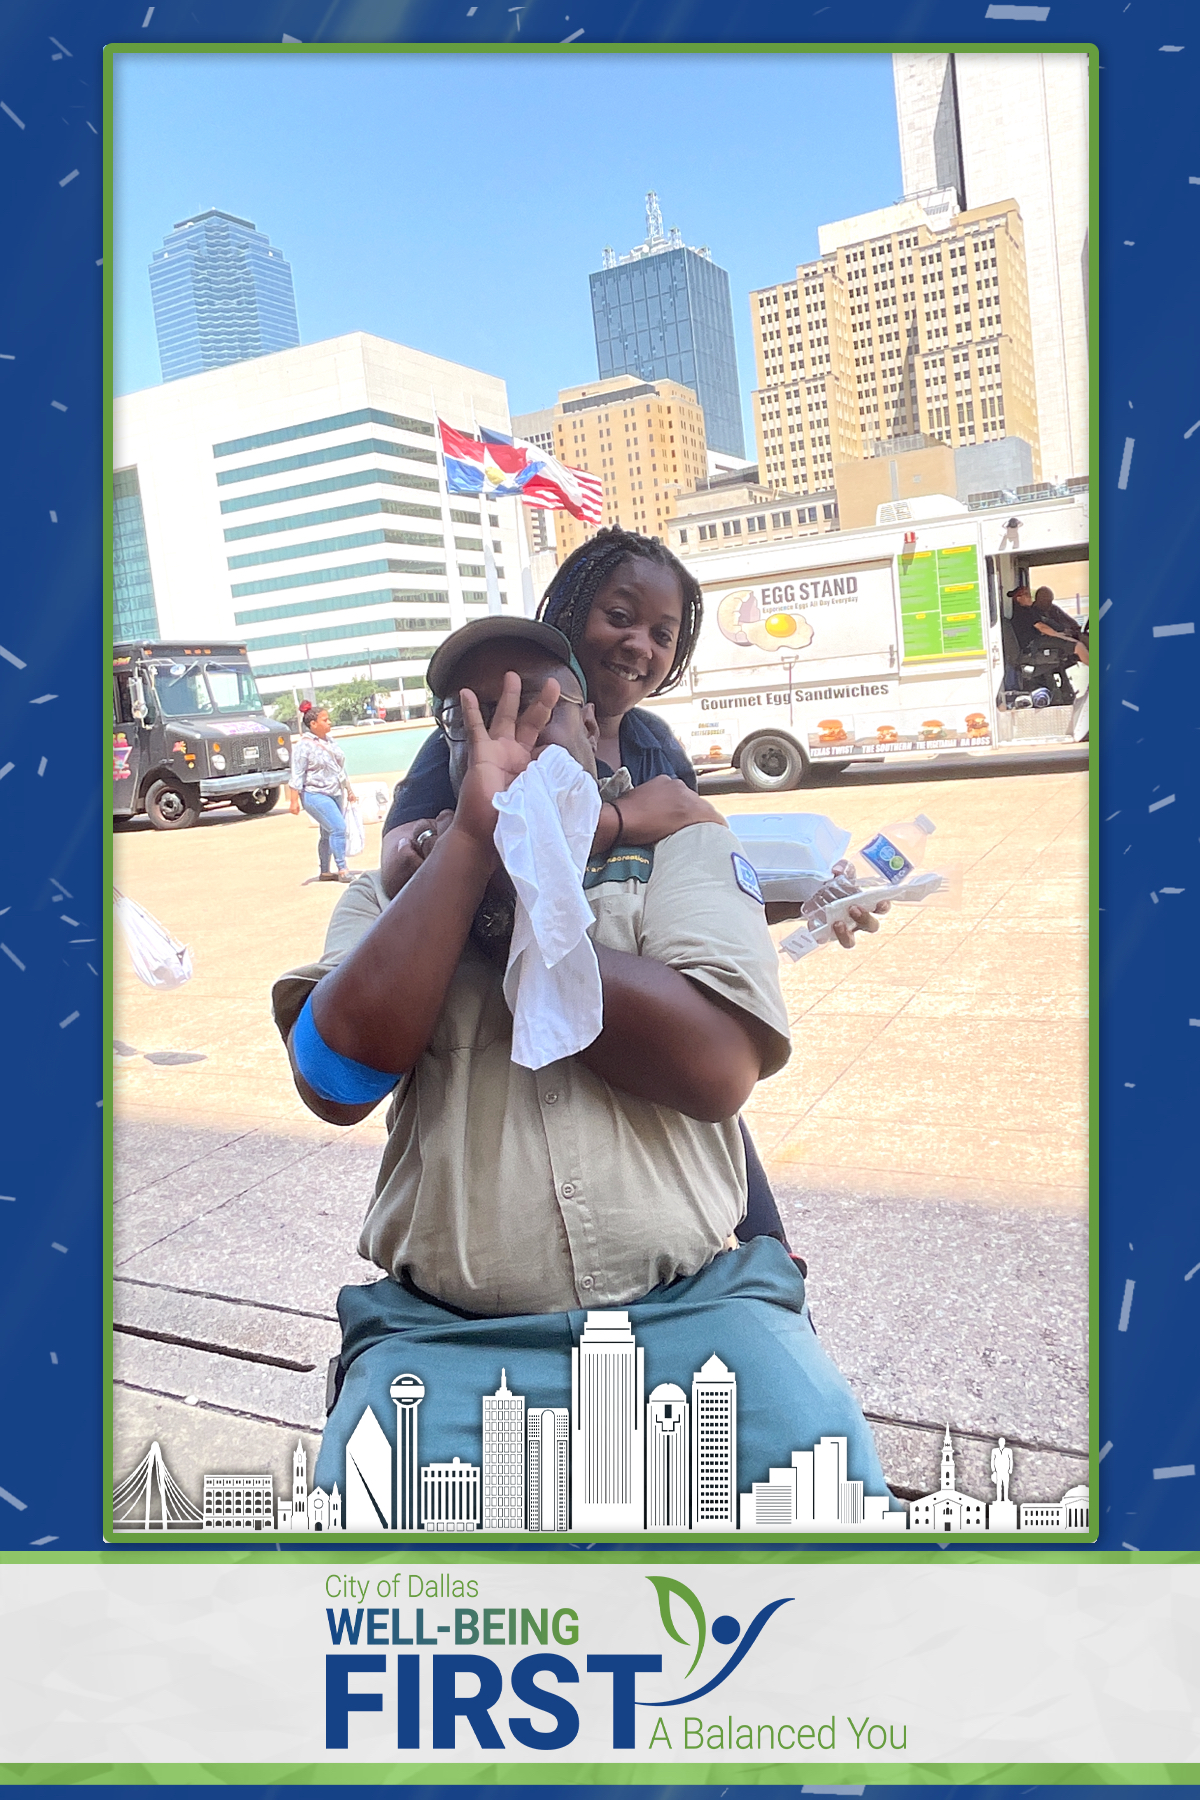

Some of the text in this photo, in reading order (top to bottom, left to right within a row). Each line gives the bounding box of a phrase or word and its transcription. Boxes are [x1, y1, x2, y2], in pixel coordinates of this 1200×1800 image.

[761, 576, 858, 606] EGG STAND
[762, 596, 858, 614] Experience Eggs All Day Everyday
[701, 683, 889, 711] Gourmet Egg Sandwiches
[916, 741, 926, 750] THE
[971, 736, 990, 746] BOSS
[811, 745, 855, 757] TEXAS TWIST
[862, 742, 912, 754] THE SOUTHERN
